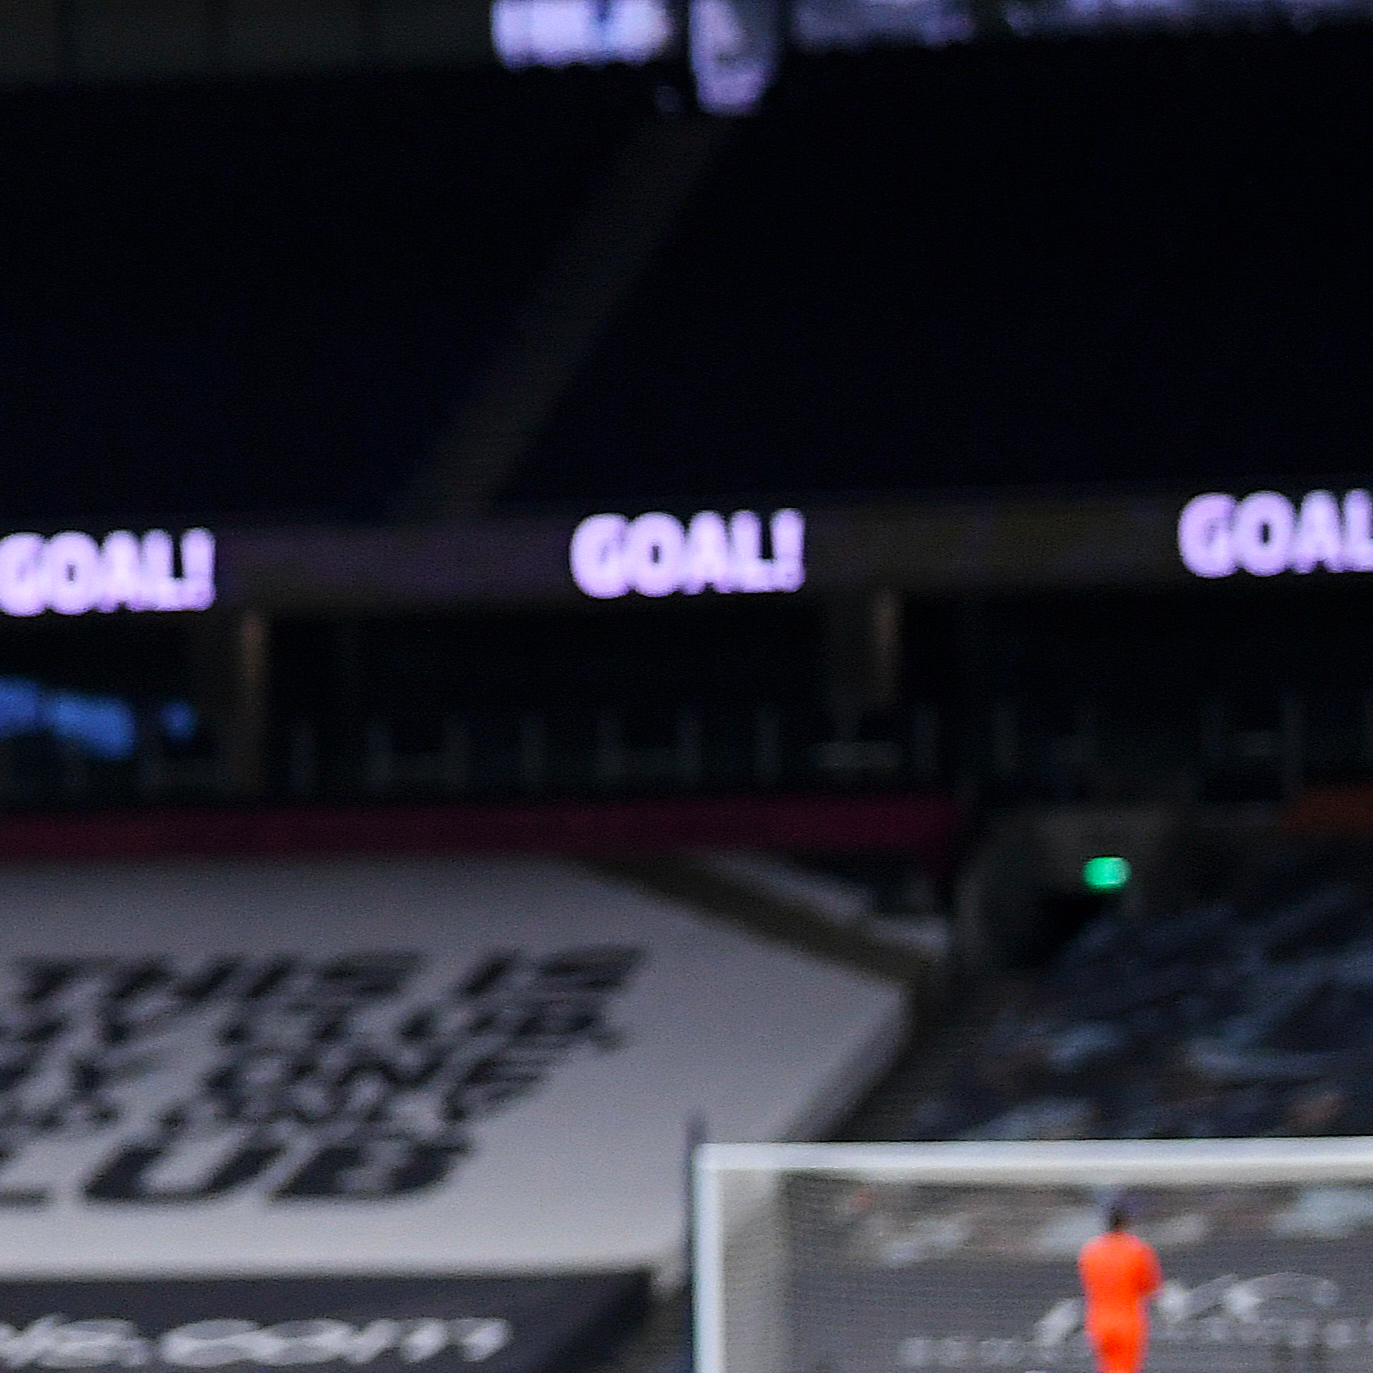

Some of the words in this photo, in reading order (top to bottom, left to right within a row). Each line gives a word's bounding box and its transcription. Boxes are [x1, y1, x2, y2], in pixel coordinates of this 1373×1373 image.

[569, 507, 805, 599] GOAL!
[10, 946, 427, 1003] THIS
[456, 941, 649, 1001] IS
